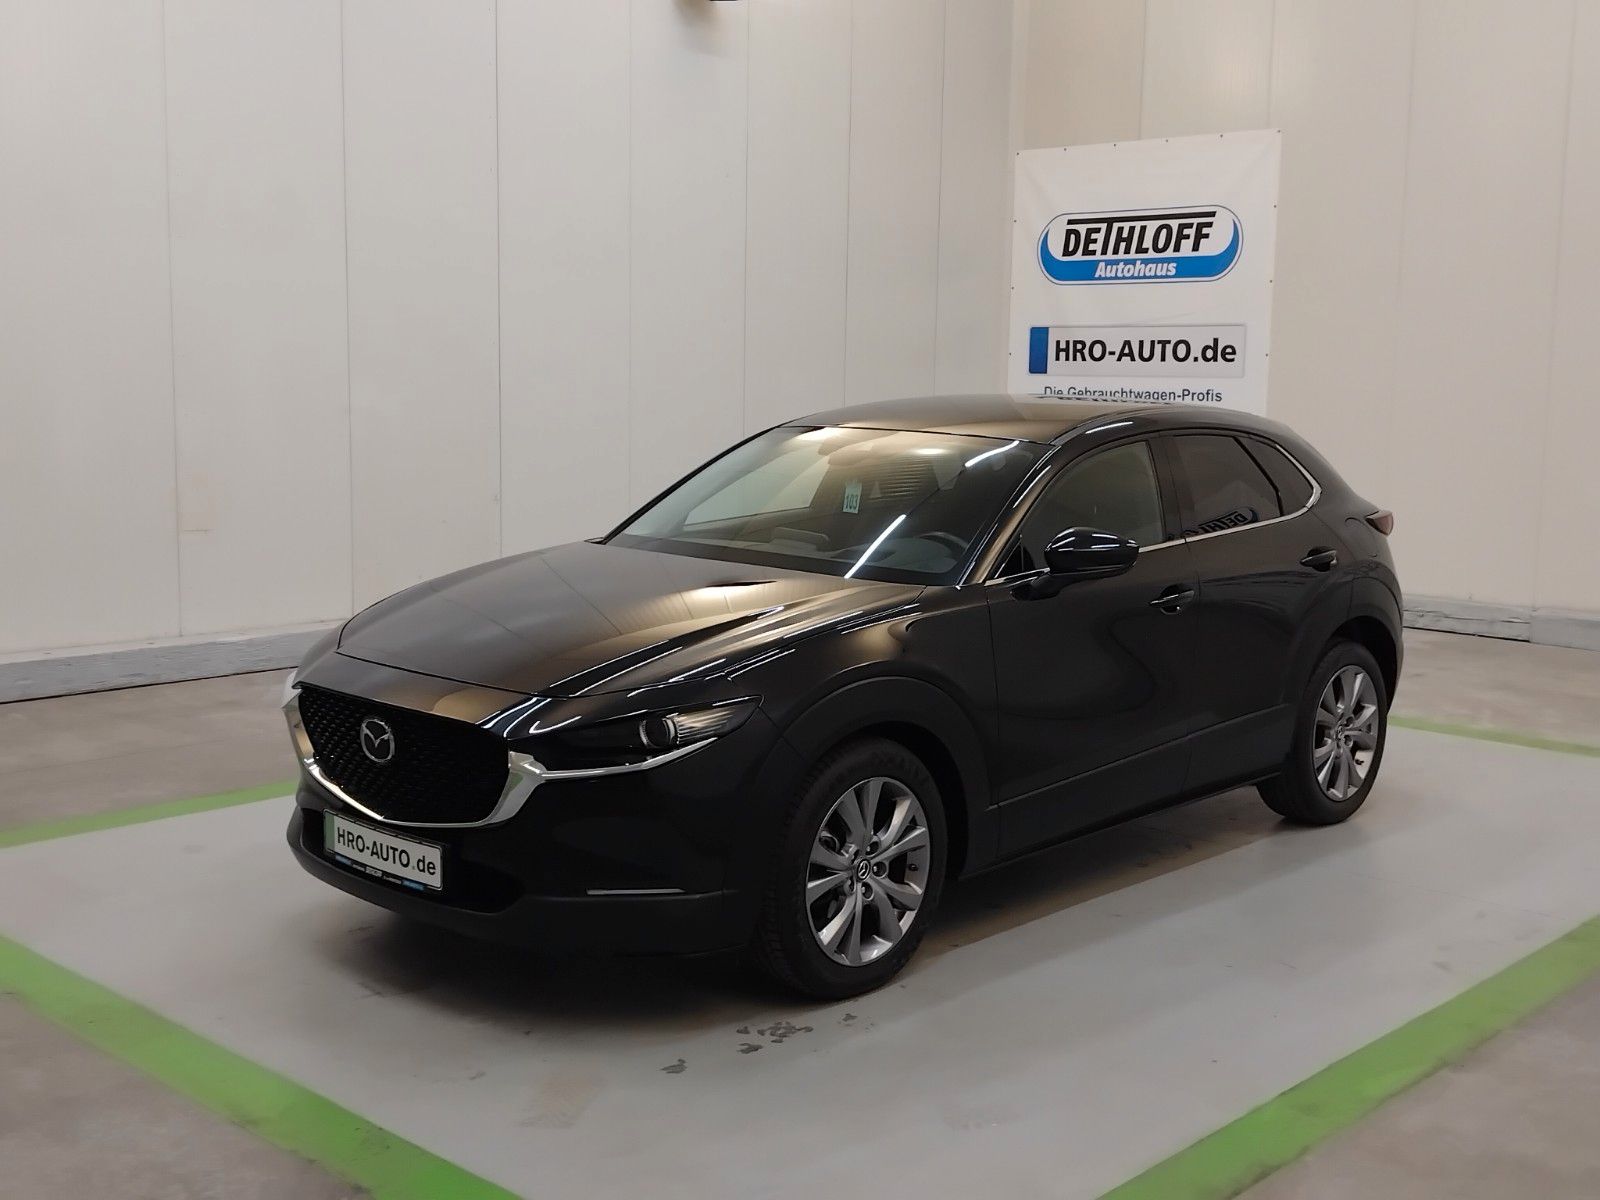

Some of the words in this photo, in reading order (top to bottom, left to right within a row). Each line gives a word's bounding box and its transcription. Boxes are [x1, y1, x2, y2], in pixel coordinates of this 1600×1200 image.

[1062, 211, 1217, 257] DETHLOFF
[1094, 260, 1177, 278] Autohaus
[1054, 338, 1237, 363] HRO-AUTO.de
[1044, 386, 1064, 396] Die
[337, 827, 436, 876] HRO-AUTO.de
